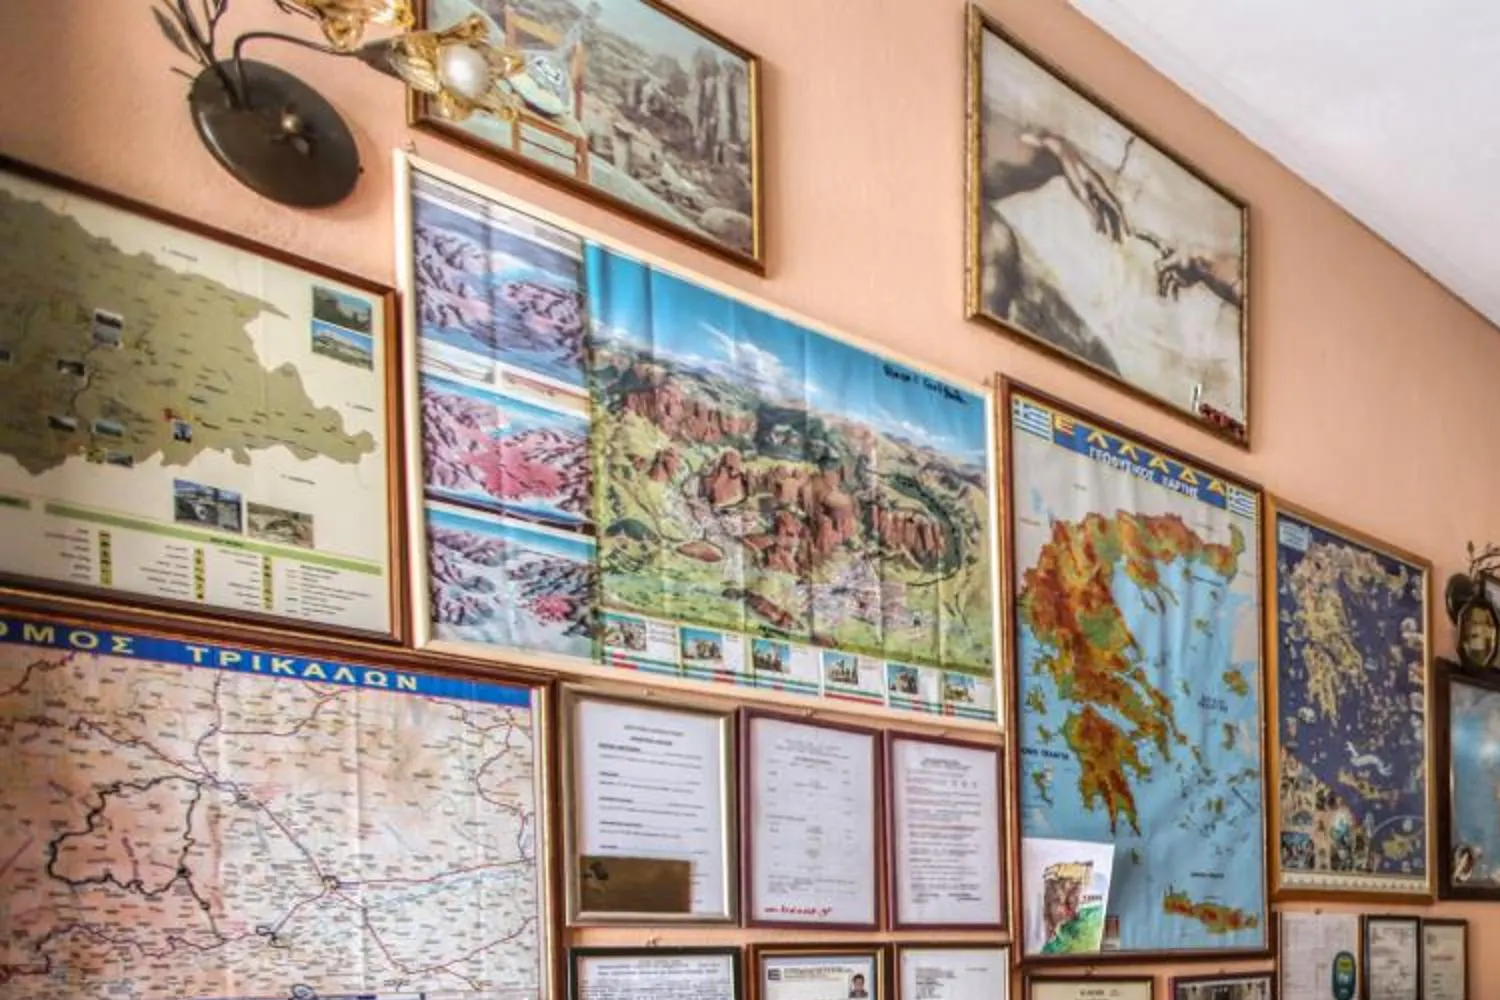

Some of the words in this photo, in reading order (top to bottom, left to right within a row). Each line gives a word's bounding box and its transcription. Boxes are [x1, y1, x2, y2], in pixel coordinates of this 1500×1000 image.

[1054, 414, 1226, 497] ΕΛΛΑΔΑ
[0, 621, 135, 655] ΜΟΣ
[185, 644, 418, 691] ΤΡΙΚΑΛΩΝ
